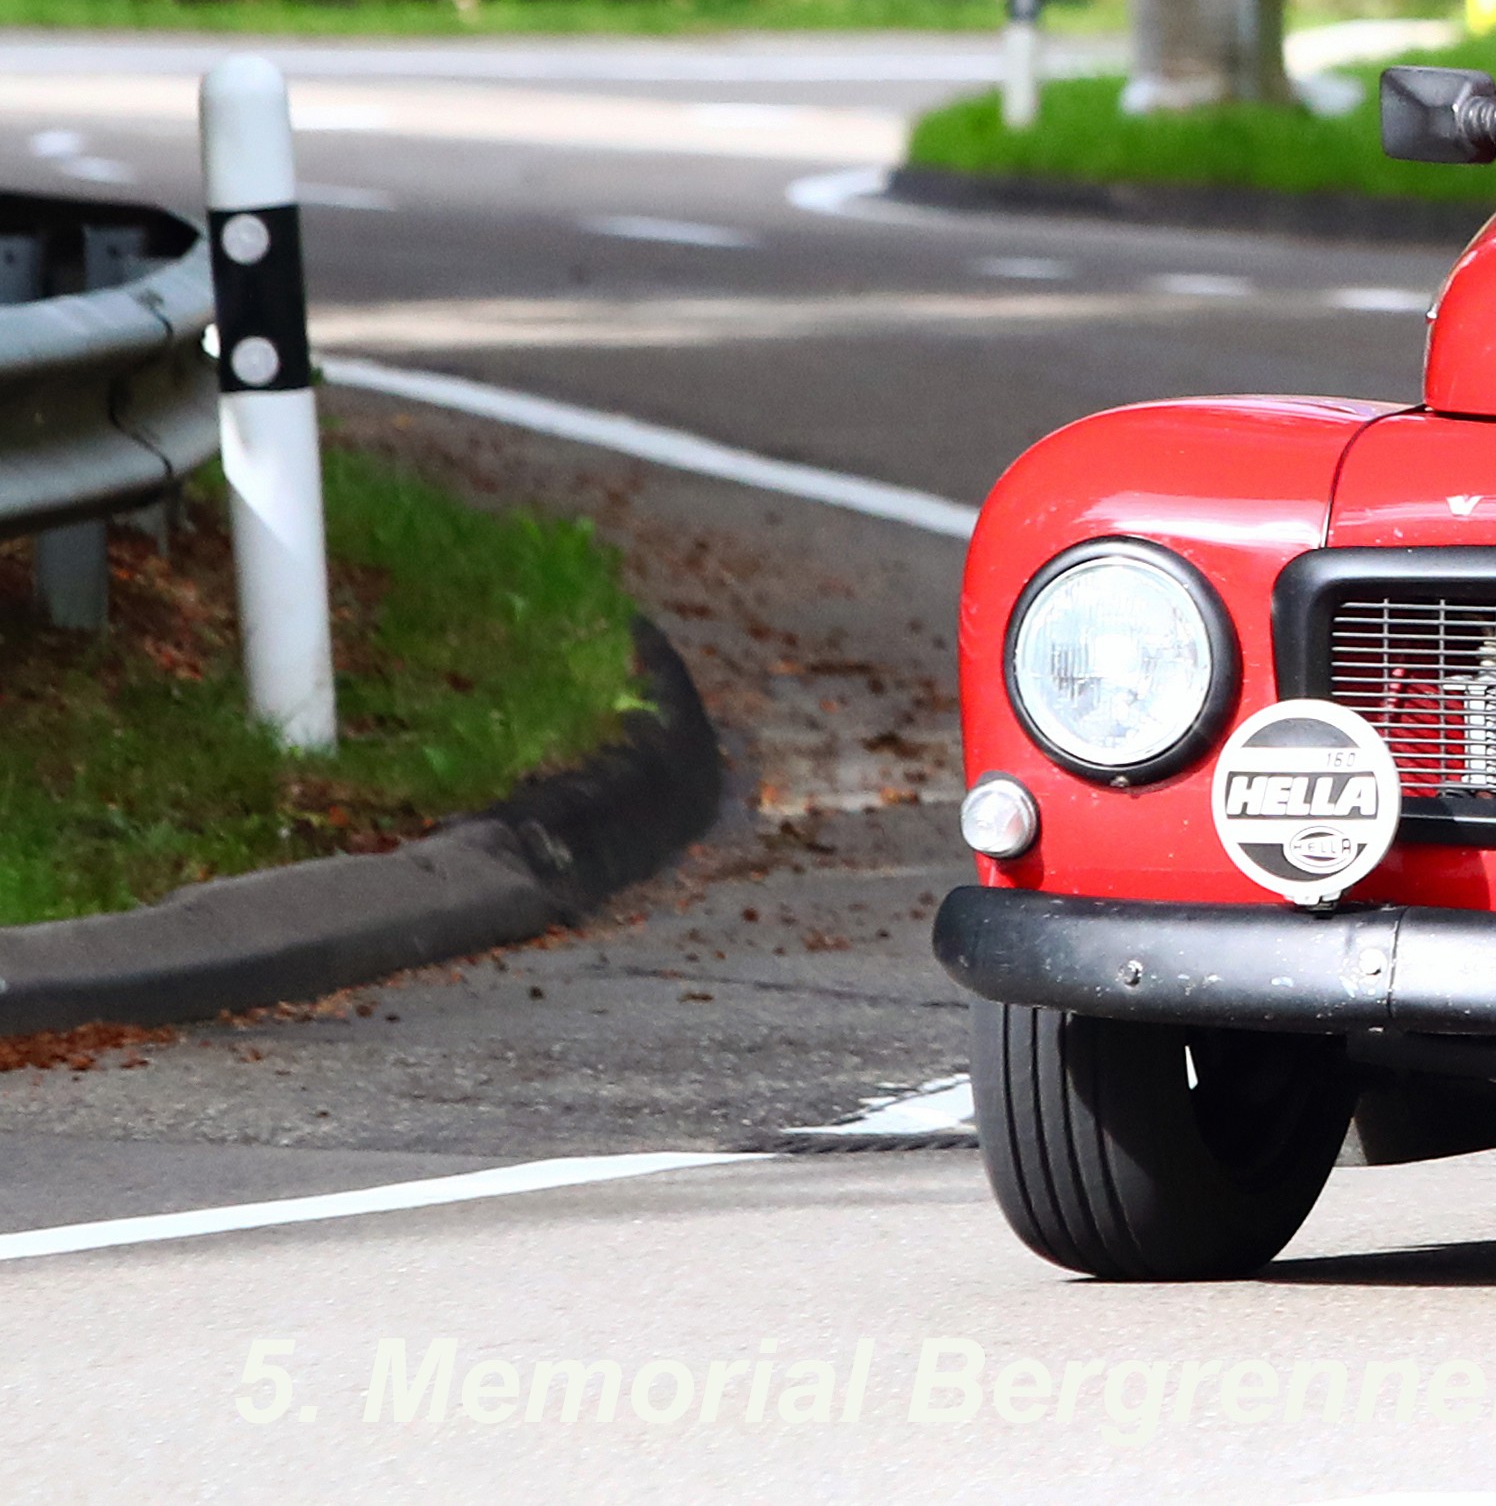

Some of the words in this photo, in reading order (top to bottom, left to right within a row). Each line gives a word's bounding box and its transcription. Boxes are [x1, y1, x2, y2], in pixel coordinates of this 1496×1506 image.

[1326, 752, 1356, 768] 160
[1226, 775, 1376, 816] HELLA
[1293, 838, 1351, 855] HELLA
